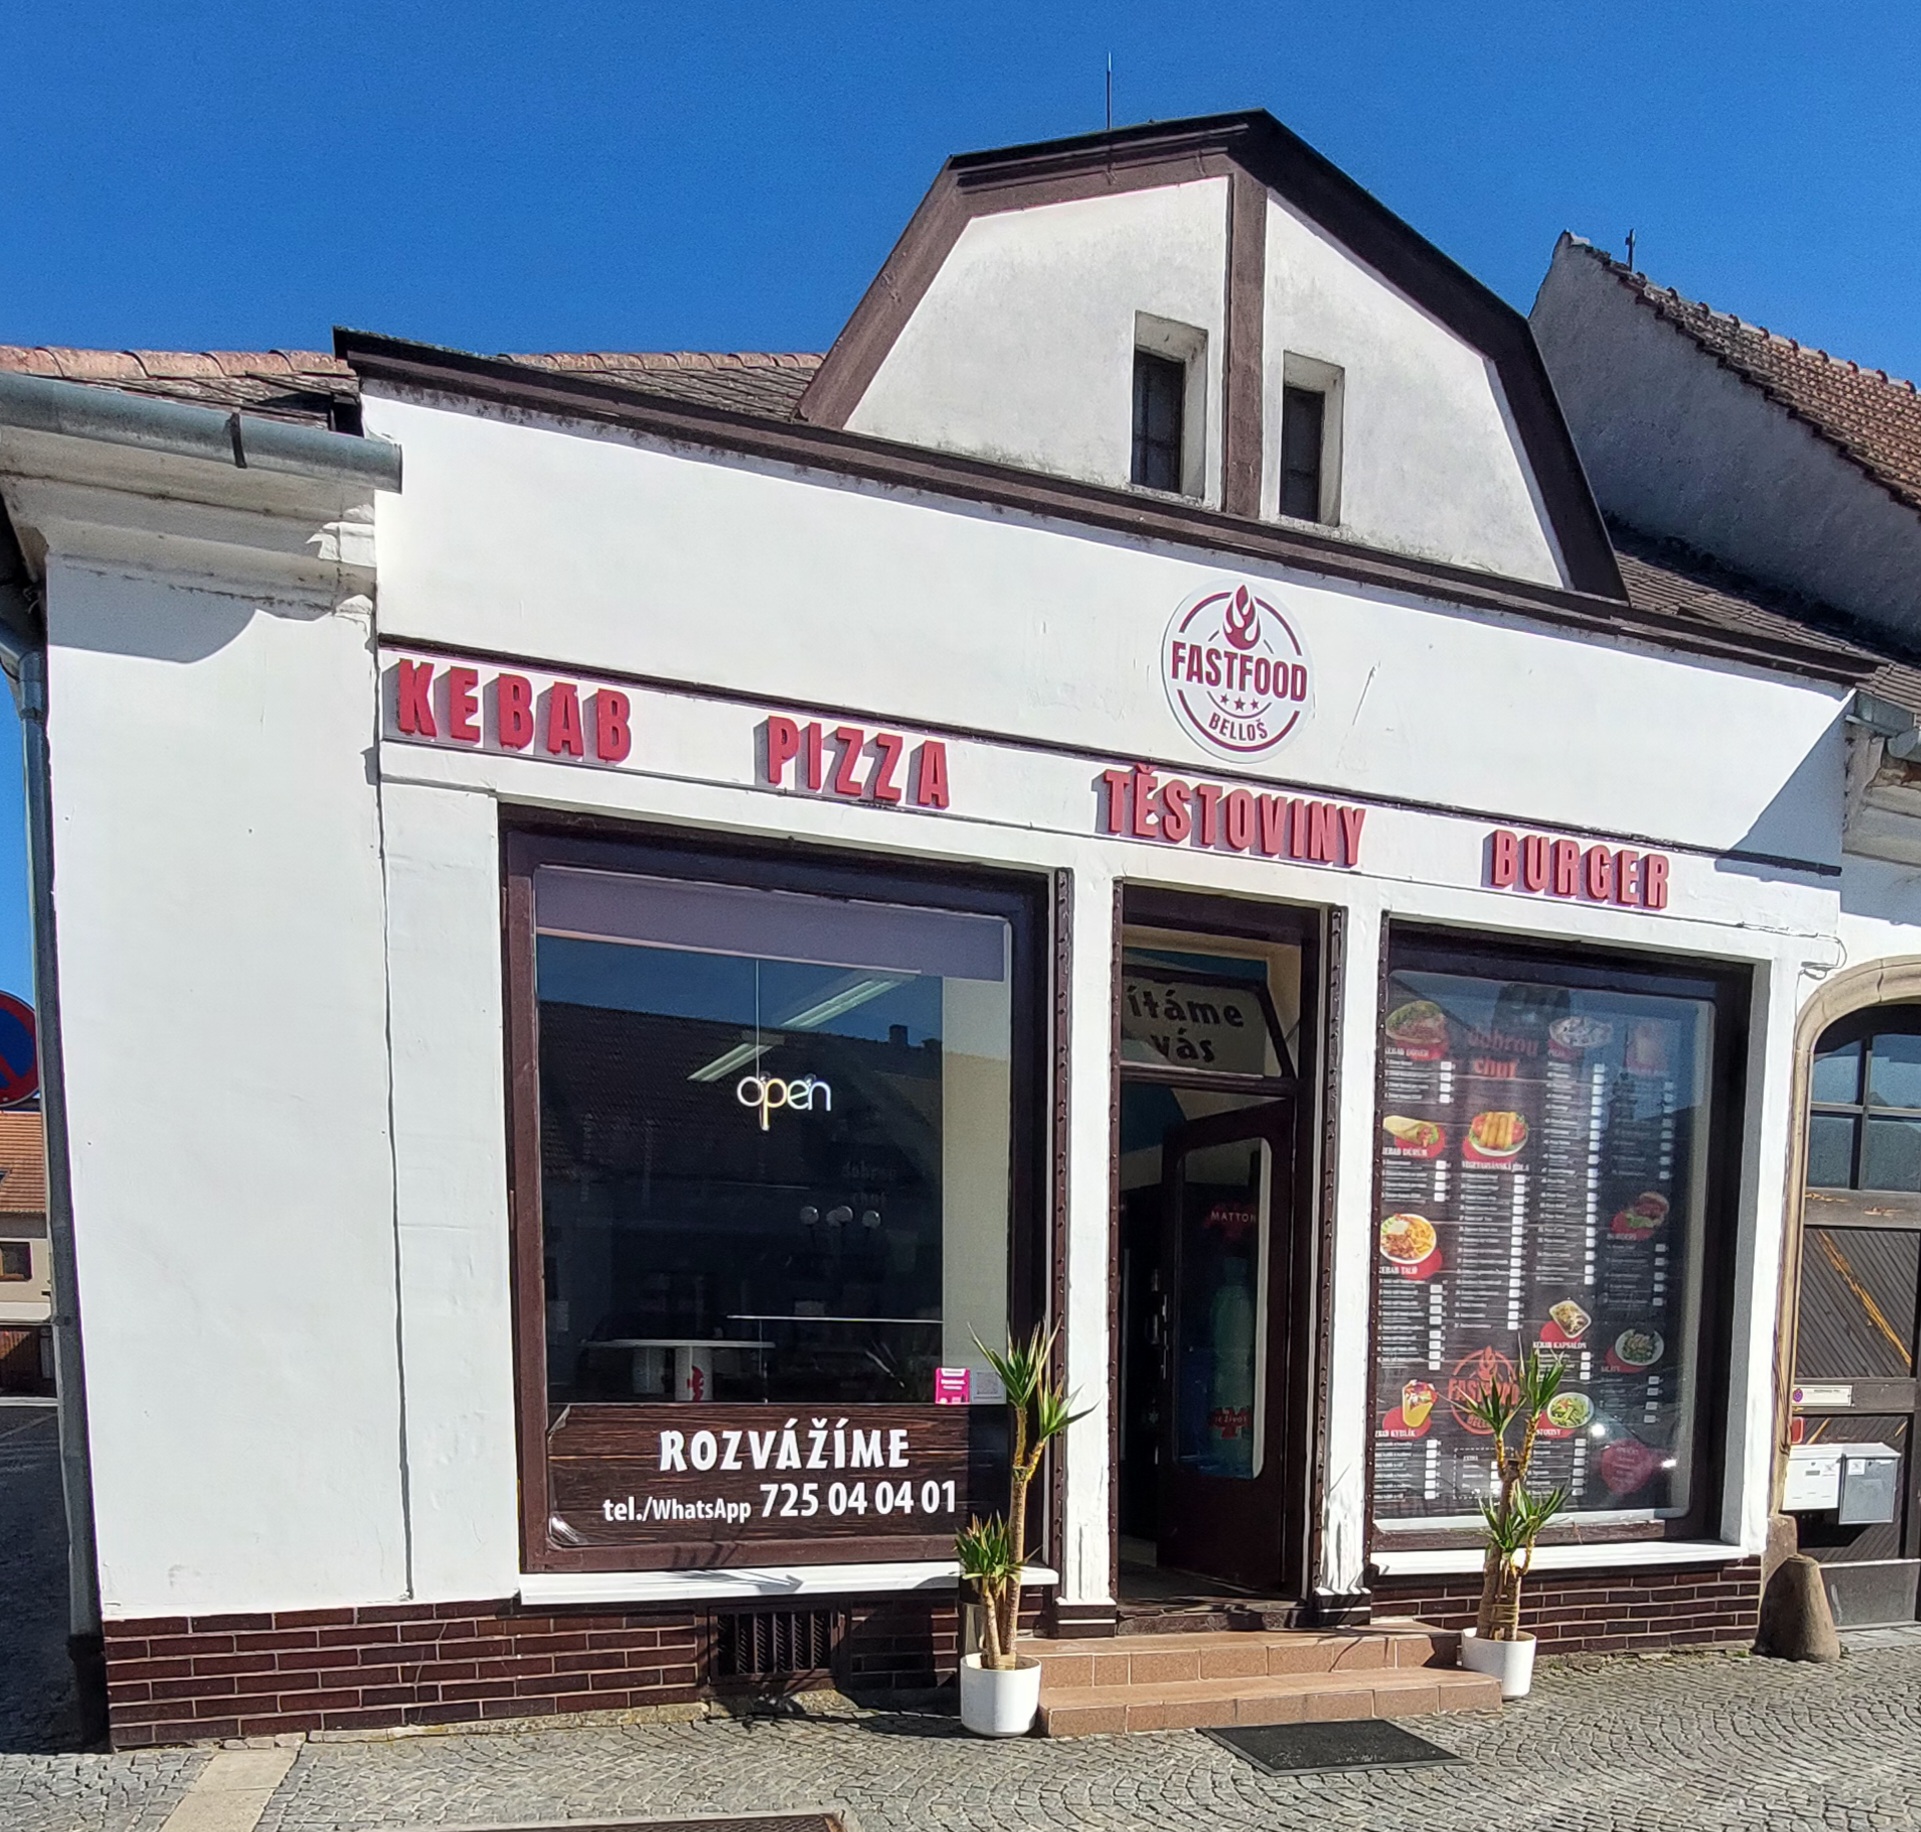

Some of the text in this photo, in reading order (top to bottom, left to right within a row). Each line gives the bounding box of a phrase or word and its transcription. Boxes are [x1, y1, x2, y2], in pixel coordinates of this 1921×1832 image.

[1171, 640, 1308, 702] FASTFOOD
[394, 657, 631, 765] KEBAB
[1208, 712, 1268, 741] BELLOŠ
[764, 715, 949, 809] PIZZA
[1101, 764, 1366, 867] TĚSTOVINY
[1488, 829, 1669, 909] BURGER
[1126, 985, 1245, 1028] ítáme
[1150, 1027, 1216, 1063] vás
[736, 1076, 832, 1131] open
[1210, 1210, 1256, 1223] MATTON
[659, 1417, 910, 1472] ROZVÁŽÍME
[603, 1480, 956, 1525] tel./WhatsApp 725 04 04 01
